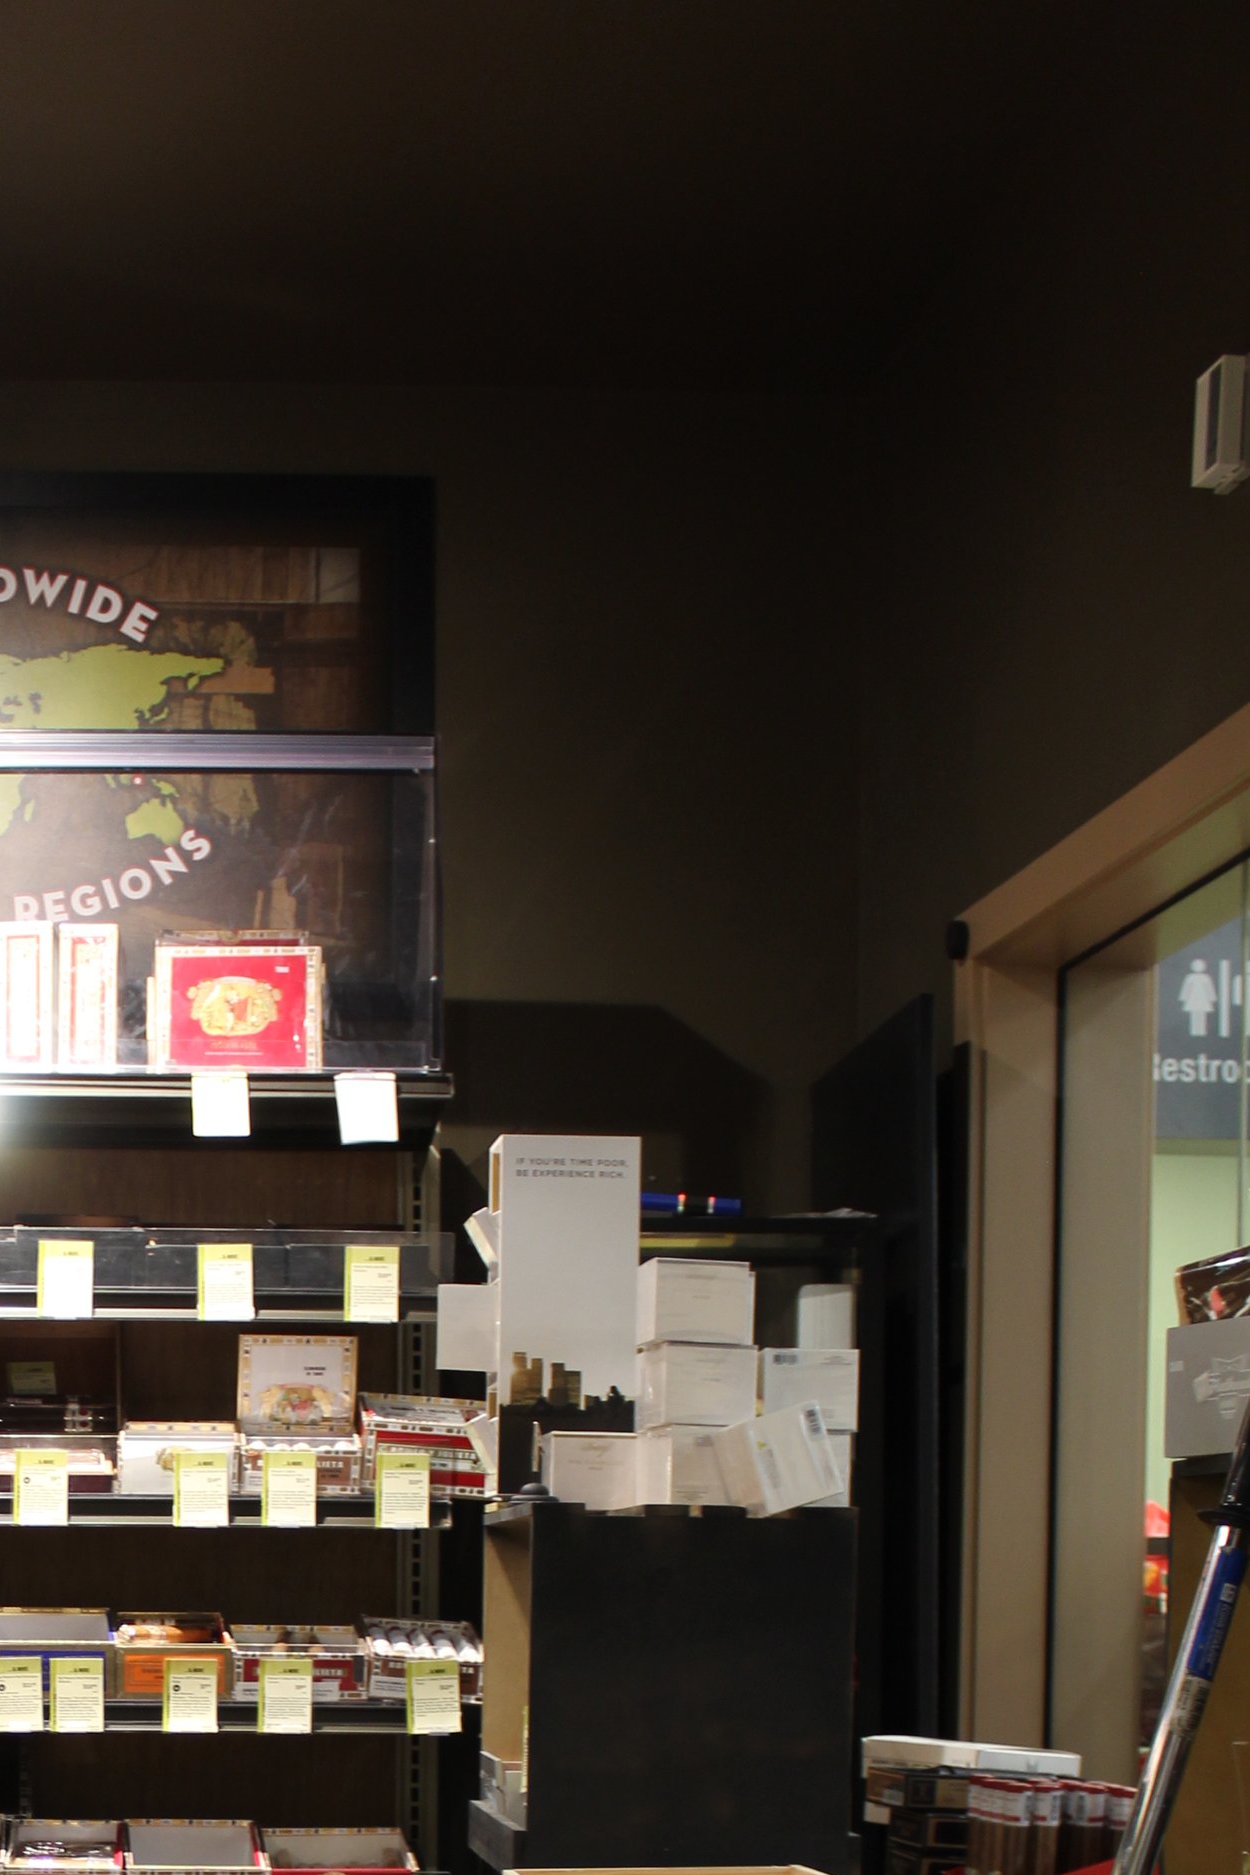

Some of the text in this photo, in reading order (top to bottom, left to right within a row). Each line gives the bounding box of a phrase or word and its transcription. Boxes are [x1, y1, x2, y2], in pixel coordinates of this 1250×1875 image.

[14, 829, 212, 922] REGIONS
[569, 1158, 593, 1167] TIME
[515, 1169, 528, 1177] BE
[531, 1169, 595, 1178] EXPERIENCE
